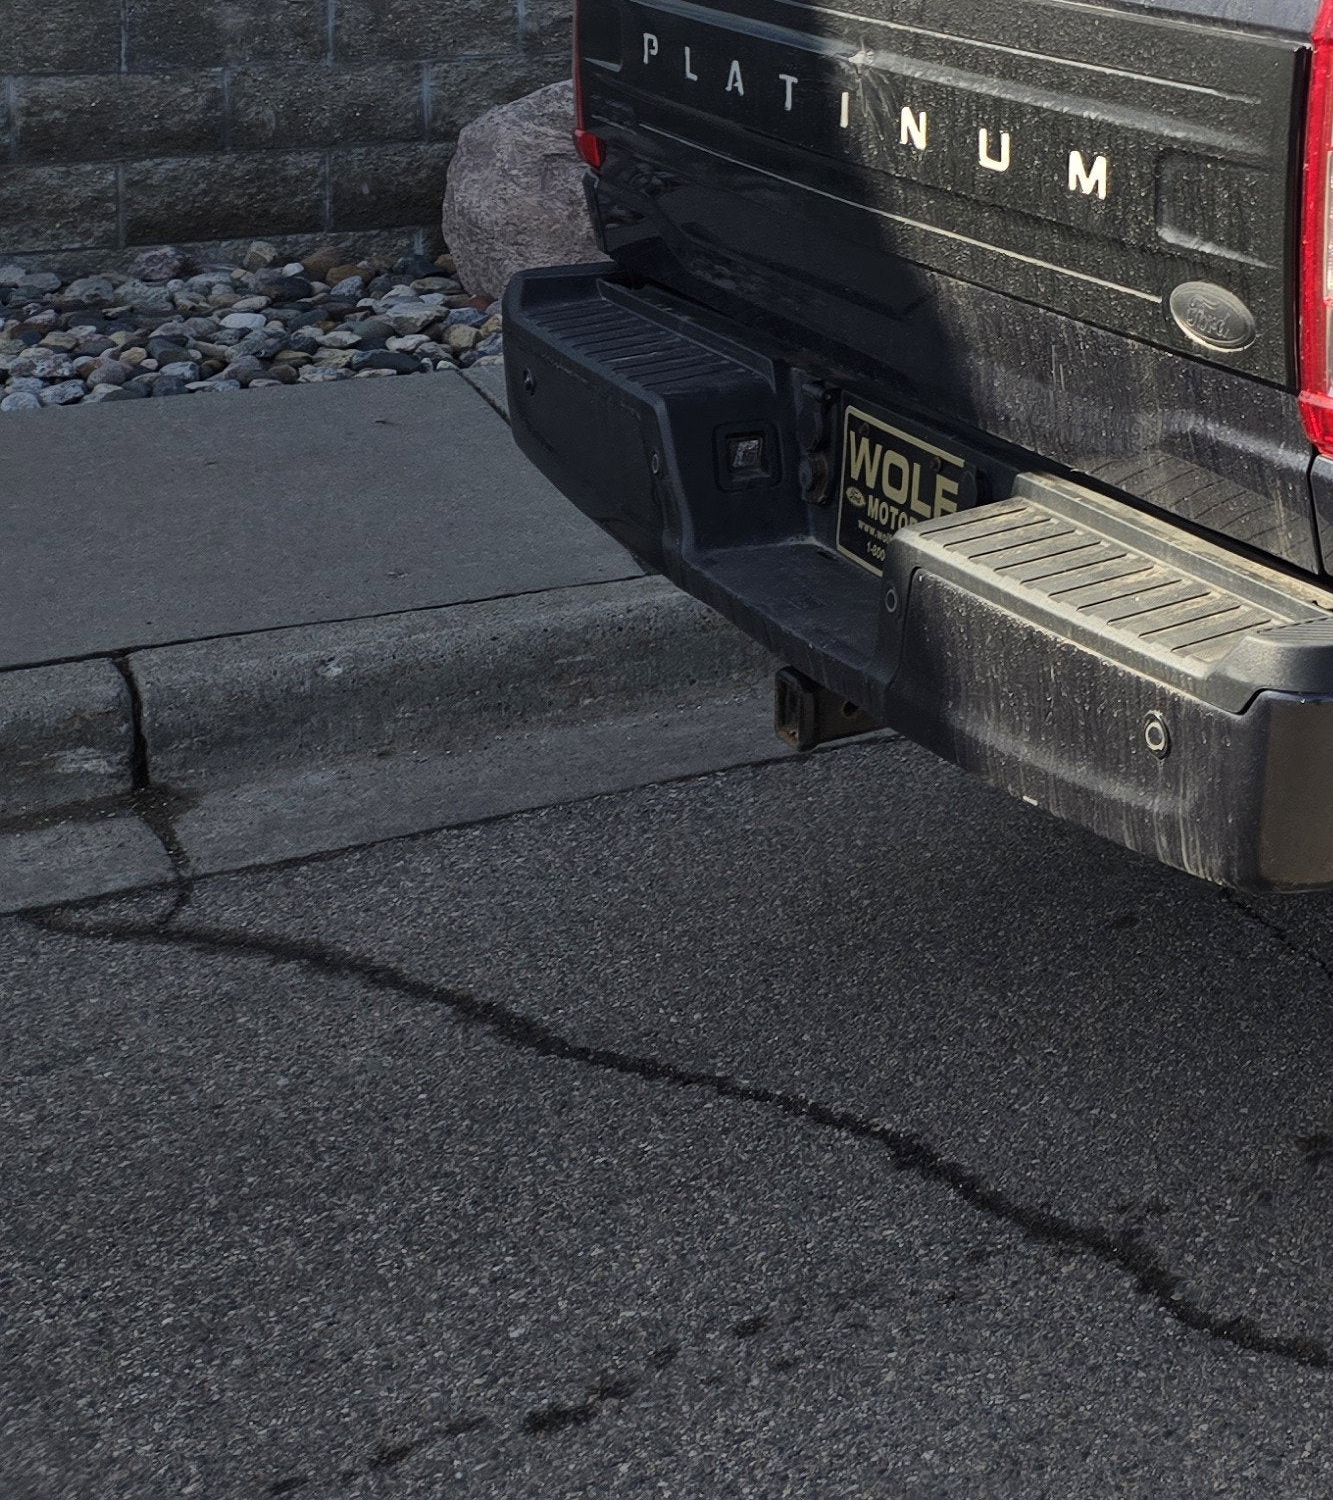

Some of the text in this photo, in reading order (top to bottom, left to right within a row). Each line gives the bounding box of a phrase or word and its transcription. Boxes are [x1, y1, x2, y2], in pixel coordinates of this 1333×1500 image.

[642, 32, 1108, 200] PLATINUM
[1186, 294, 1232, 338] Ford
[850, 430, 959, 519] WOLF
